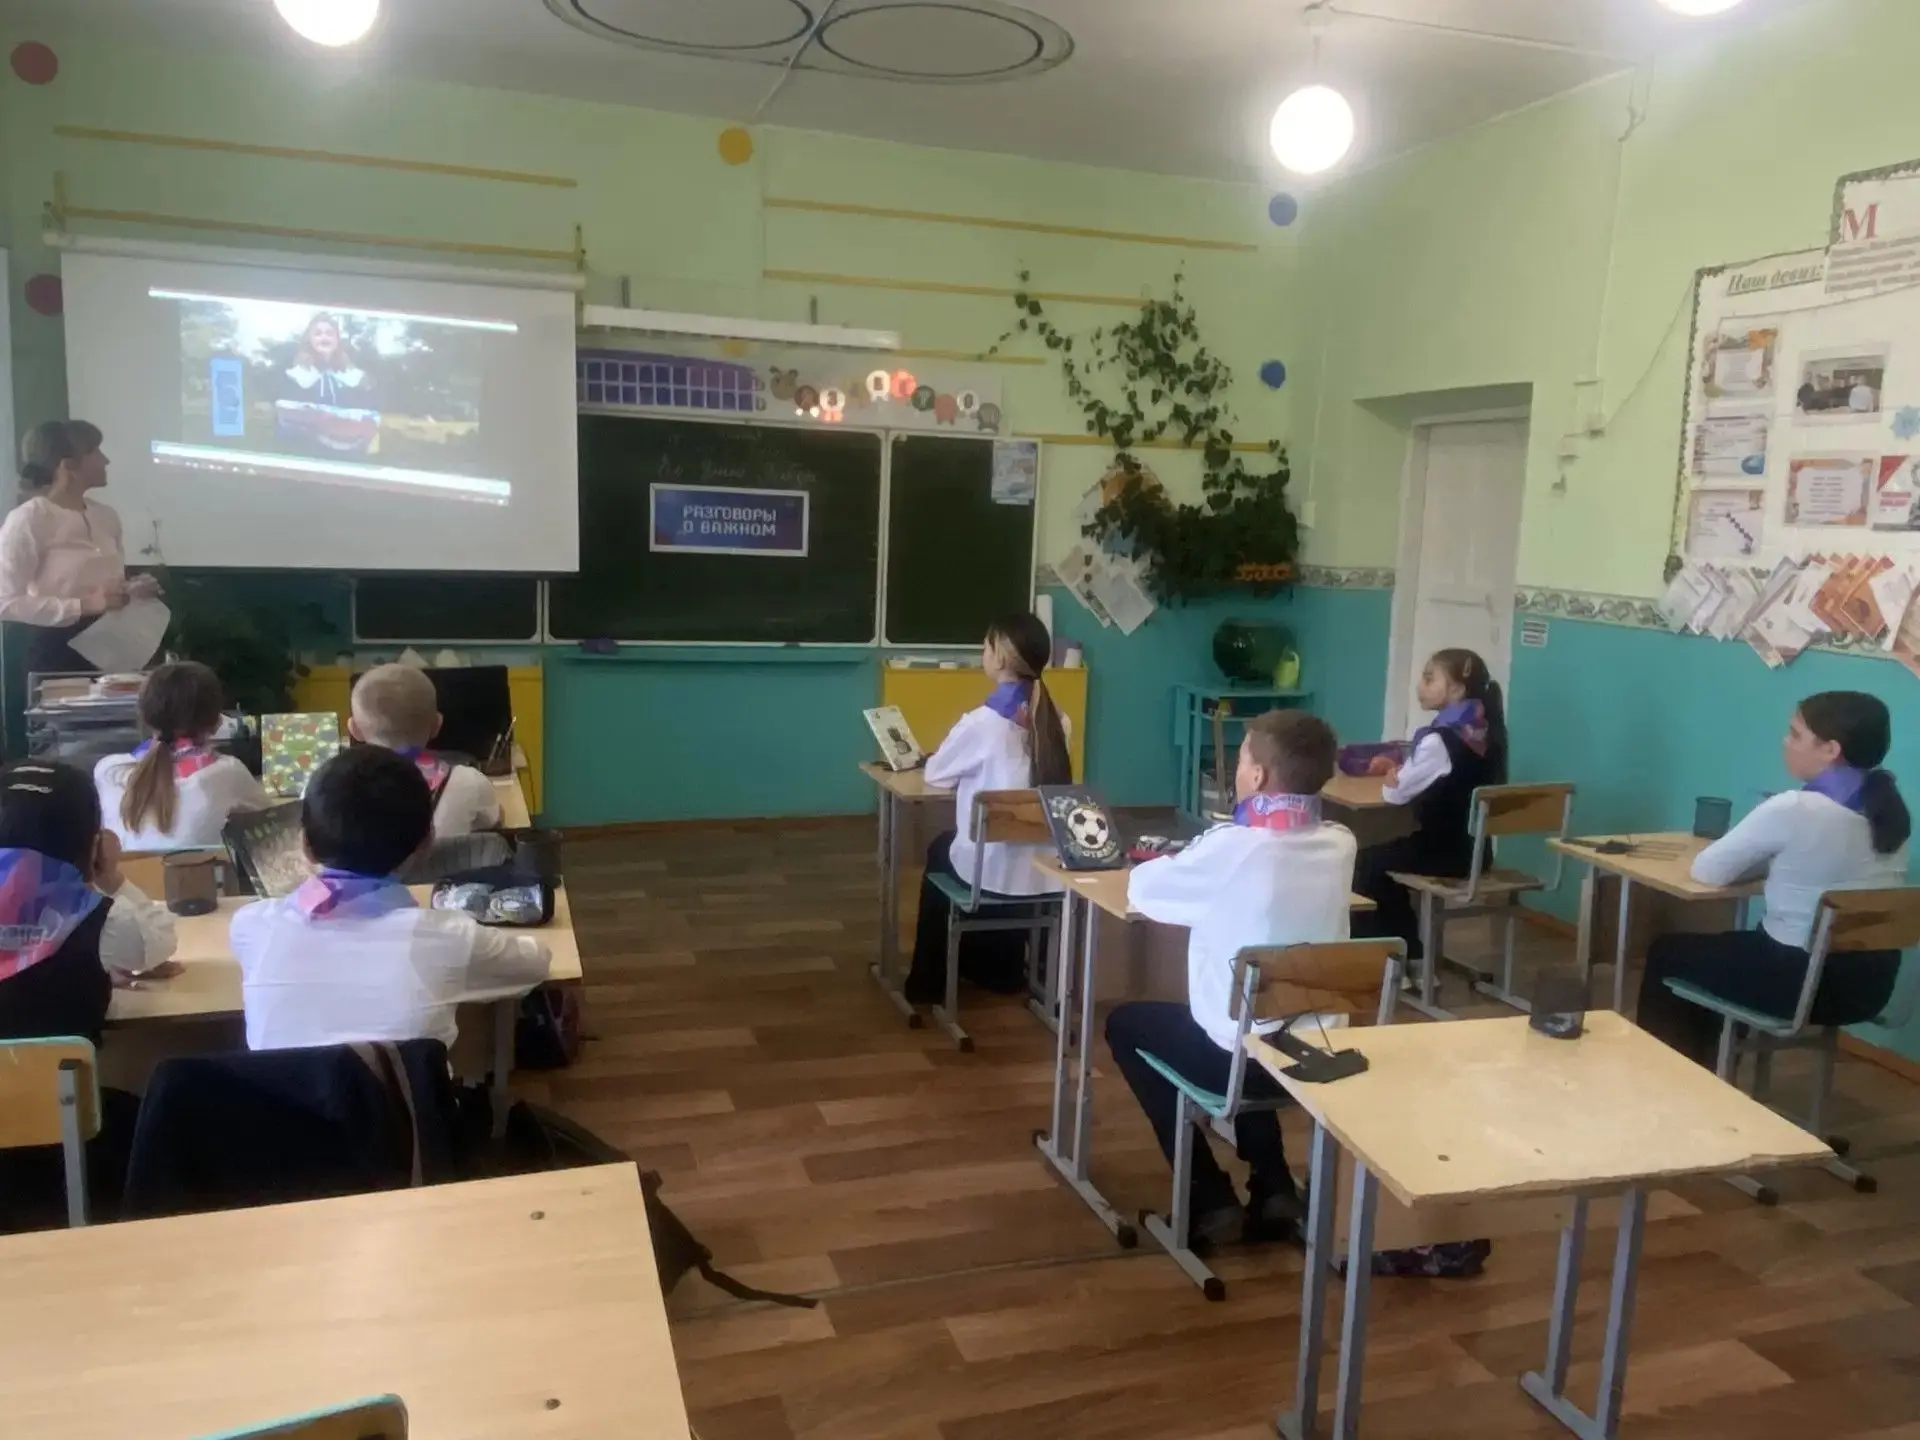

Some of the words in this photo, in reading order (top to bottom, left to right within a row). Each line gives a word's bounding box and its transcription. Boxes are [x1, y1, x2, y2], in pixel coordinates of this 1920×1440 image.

[683, 504, 777, 522] РАЗГОВОРЫ
[683, 520, 694, 533] О
[701, 520, 777, 536] ВАЖНОМ
